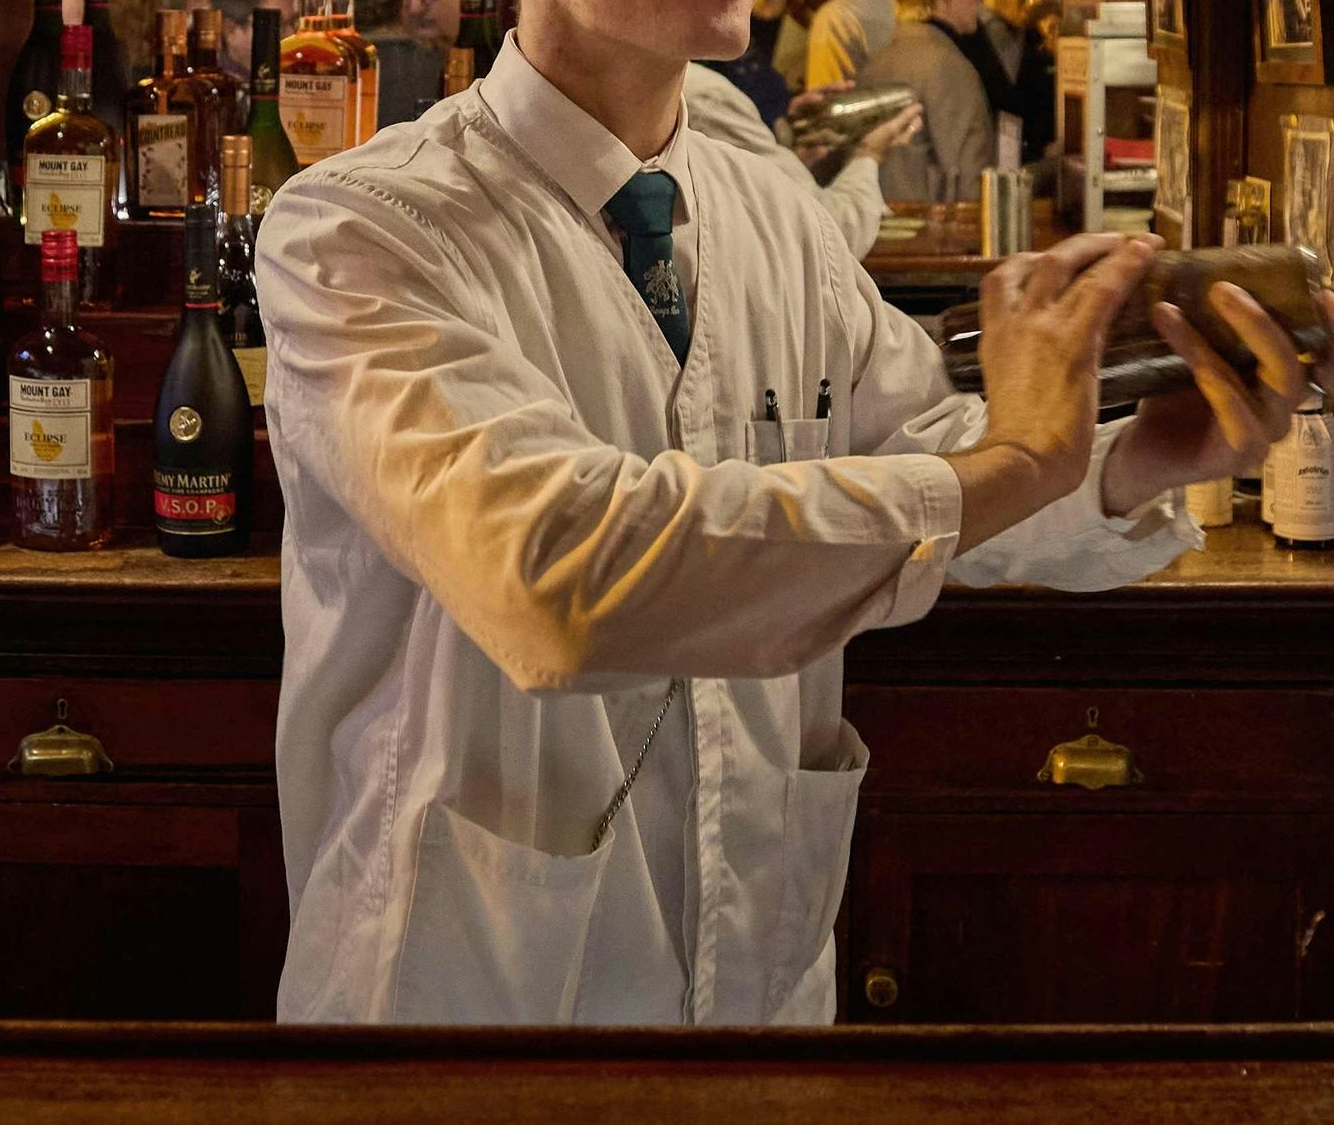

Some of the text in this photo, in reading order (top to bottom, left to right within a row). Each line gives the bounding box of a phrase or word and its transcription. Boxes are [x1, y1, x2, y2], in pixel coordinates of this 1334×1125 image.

[284, 79, 332, 92] MOUNT GAY
[38, 160, 89, 172] MOUNT GAY
[40, 203, 82, 213] ECLIPSE
[19, 384, 72, 397] MOUNT GAY
[24, 432, 67, 444] ECLIPSE
[177, 474, 228, 488] MARTIN
